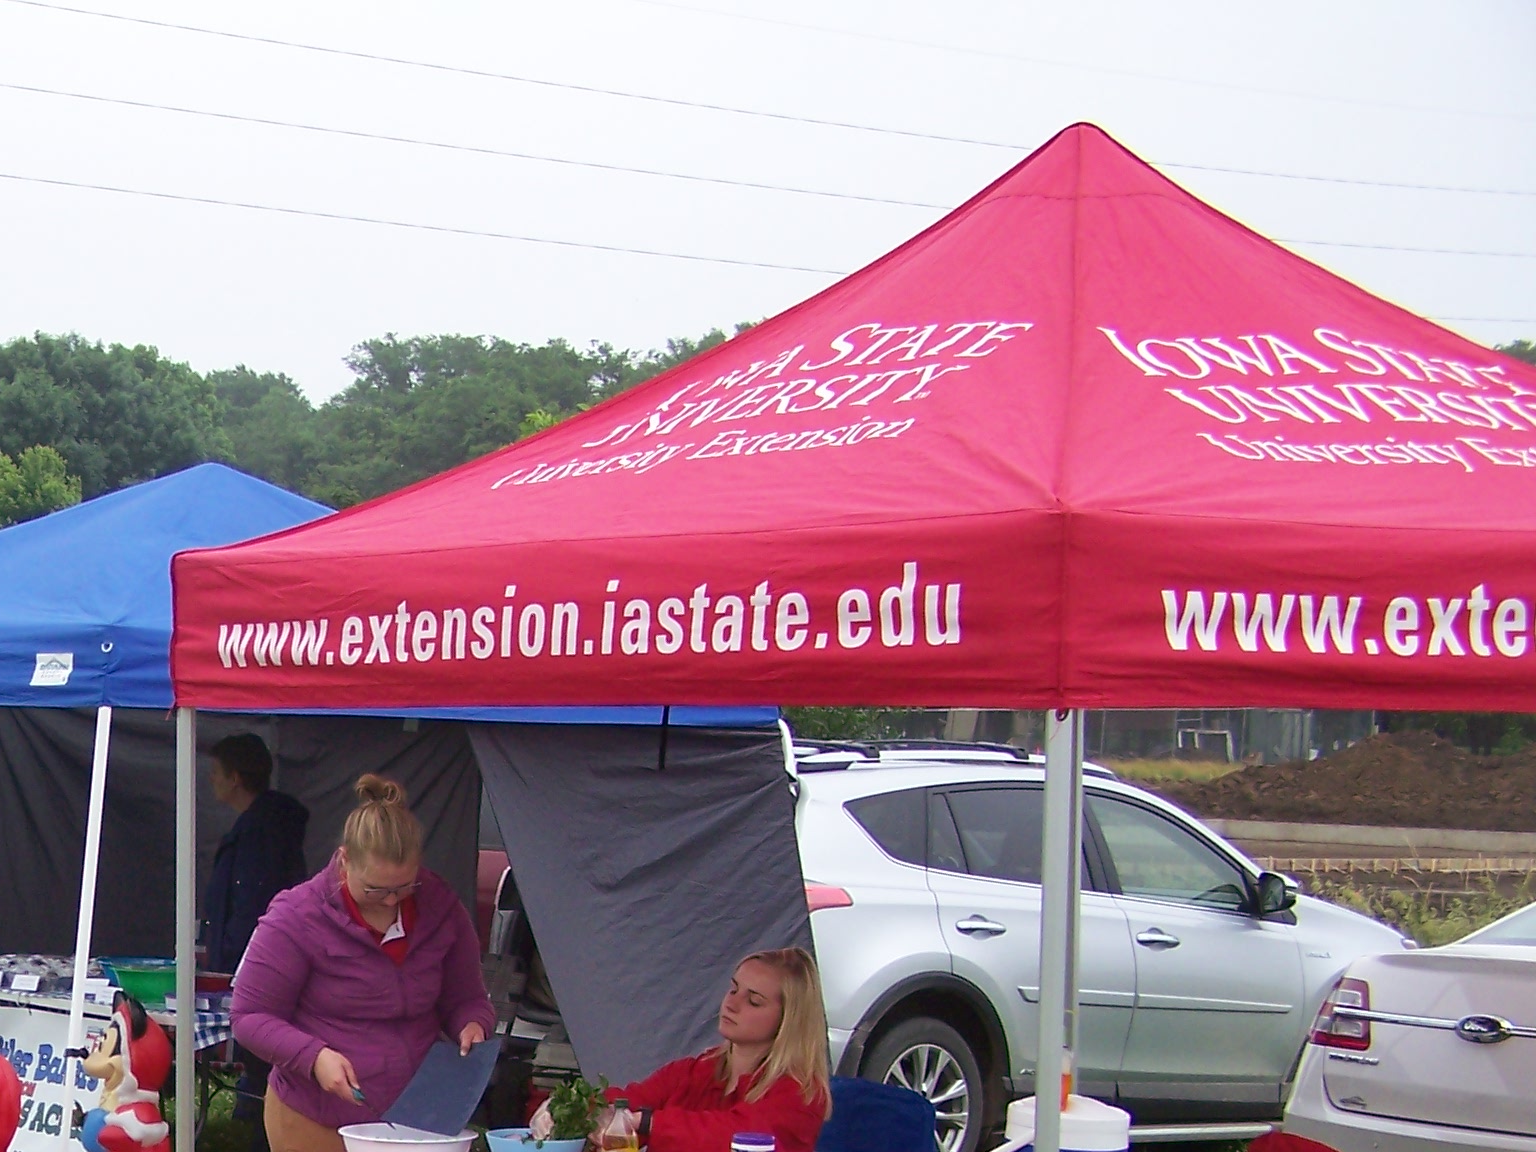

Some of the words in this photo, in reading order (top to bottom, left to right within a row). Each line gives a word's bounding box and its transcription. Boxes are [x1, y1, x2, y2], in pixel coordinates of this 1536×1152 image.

[655, 345, 805, 411] IWA
[799, 322, 1035, 371] STATE
[1096, 326, 1339, 380] IOWA
[1312, 327, 1536, 397] STATE
[490, 442, 696, 490] University
[685, 415, 915, 460] Extension
[1195, 432, 1475, 472] University
[216, 561, 962, 670] www.extension.iastate.edu
